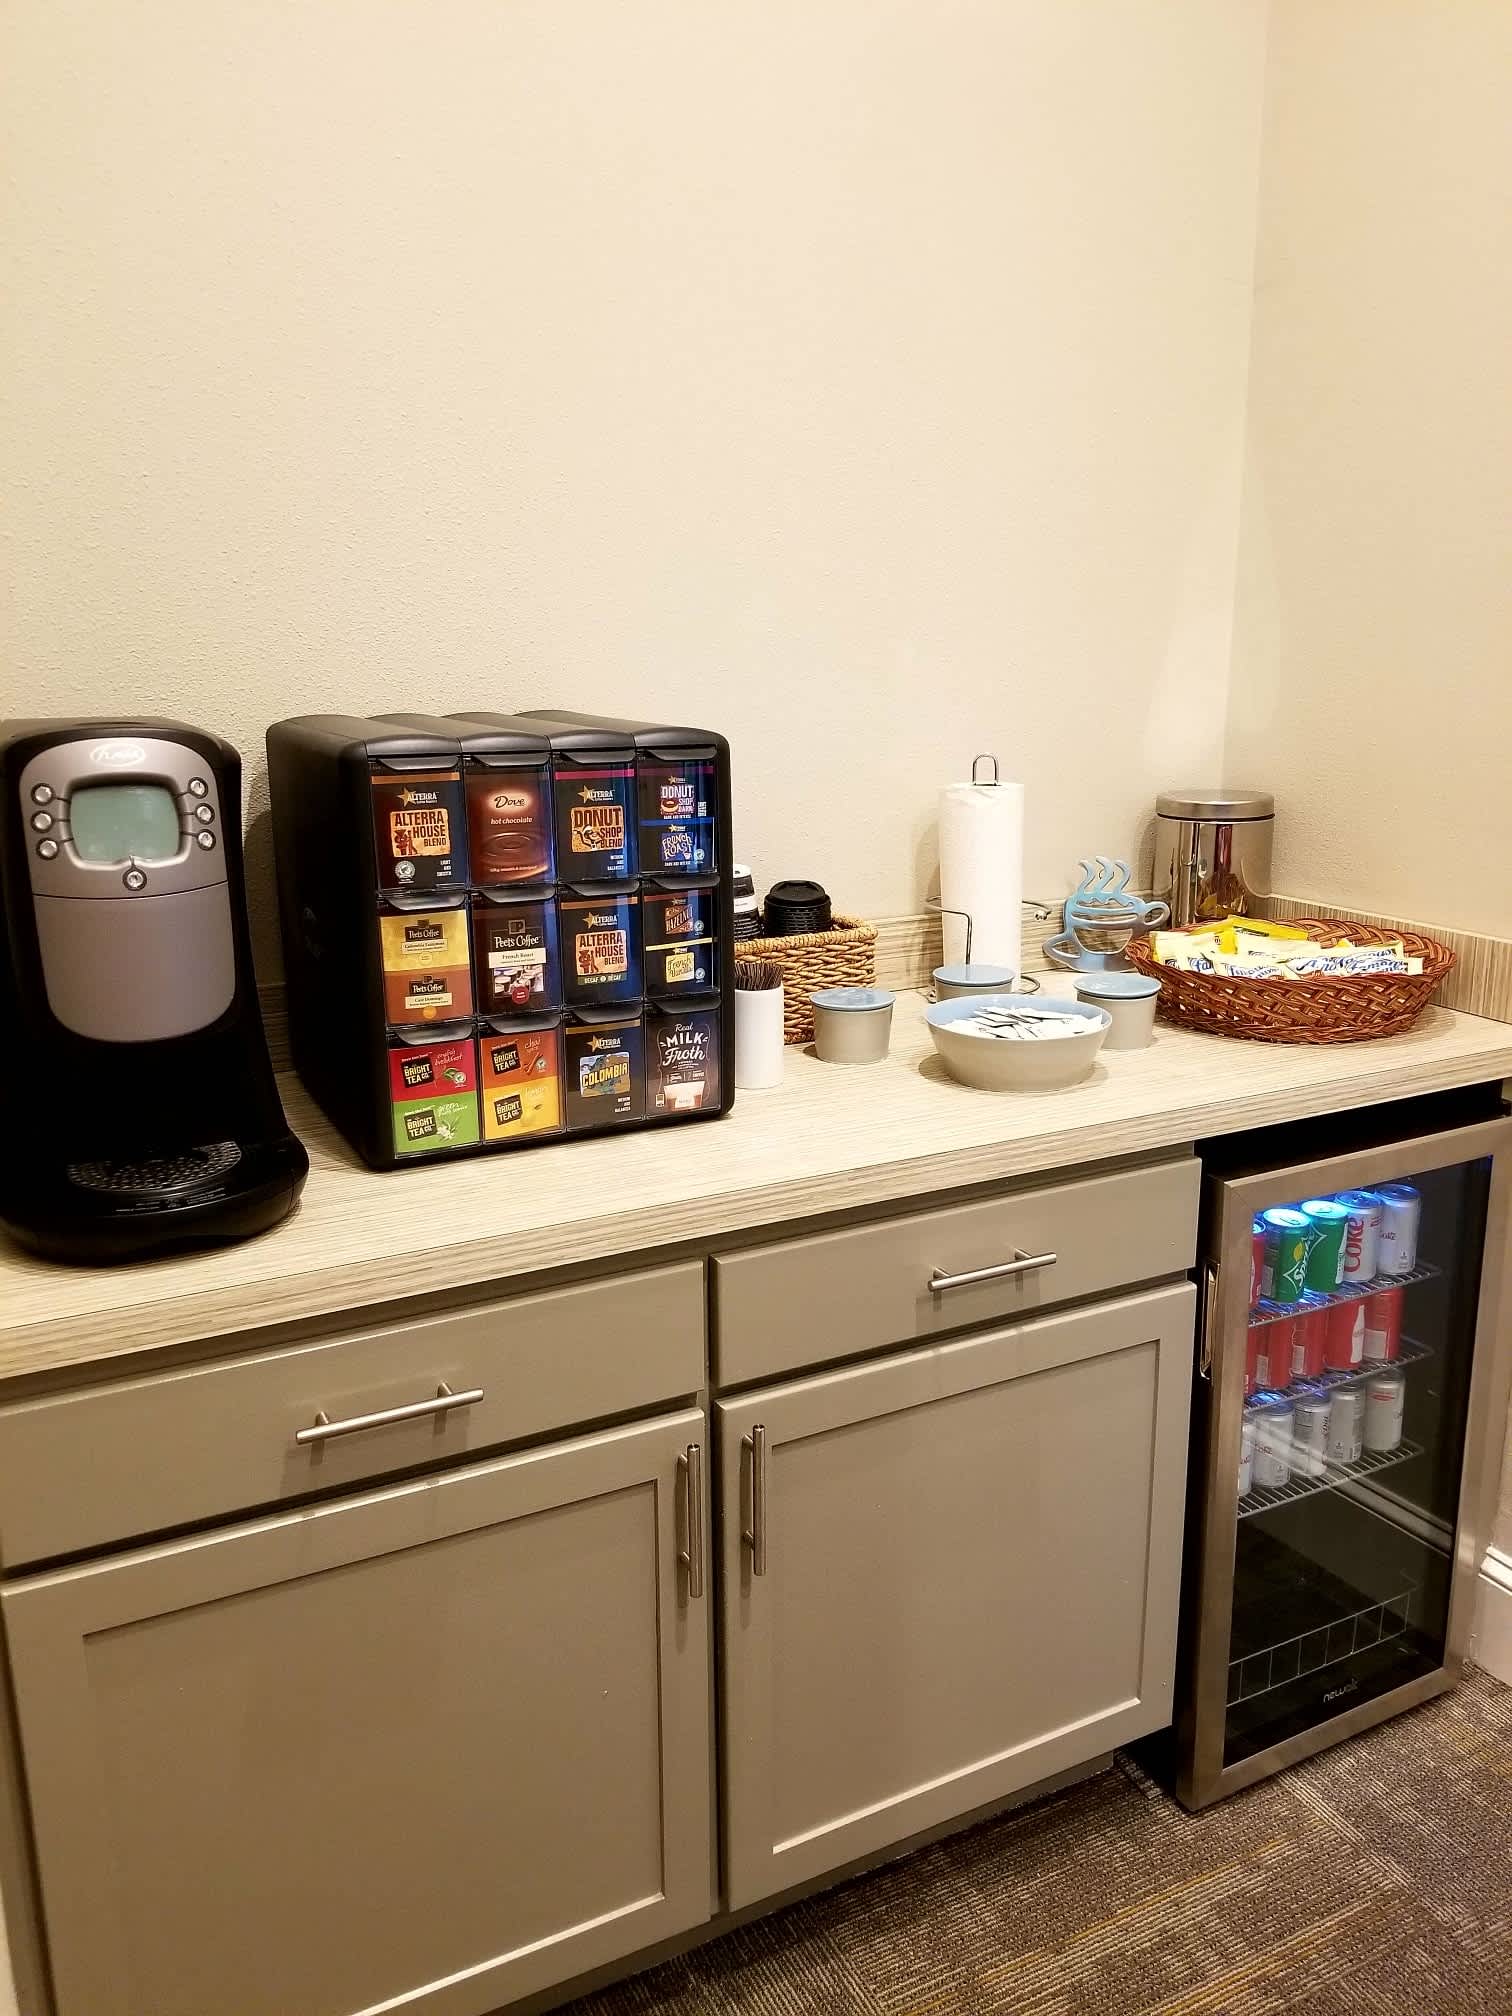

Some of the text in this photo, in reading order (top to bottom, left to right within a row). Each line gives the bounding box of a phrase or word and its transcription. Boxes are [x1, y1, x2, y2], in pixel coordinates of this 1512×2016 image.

[408, 792, 437, 800] ALTERRA
[587, 790, 613, 798] ALTERRA
[661, 785, 694, 798] DONUT
[395, 811, 444, 826] ALTERRA
[574, 808, 621, 827] DONUT
[413, 825, 445, 838] HOUSE
[600, 827, 622, 838] SHOP
[424, 838, 447, 846] BLEND
[600, 839, 622, 848] BLEND
[592, 915, 617, 923] ALTERRA
[423, 929, 440, 937] Coffee
[516, 935, 539, 947] Coffee
[580, 932, 623, 947] ALTERRA
[595, 945, 624, 957] HOUSE
[604, 956, 624, 965] BLEND
[427, 984, 443, 992] Coffee
[675, 1022, 694, 1032] Real
[666, 1032, 704, 1047] MILK
[493, 1051, 517, 1064] BRIGHT
[662, 1046, 706, 1066] Froth
[404, 1064, 430, 1077] BRIGHT
[496, 1062, 509, 1072] TEA
[406, 1074, 422, 1085] TEA
[582, 1062, 628, 1087] COLOMBIA
[496, 1101, 520, 1114] BRIGHT
[498, 1112, 513, 1122] TEA
[407, 1117, 433, 1130] BRIGHT
[409, 1128, 425, 1137] TEA
